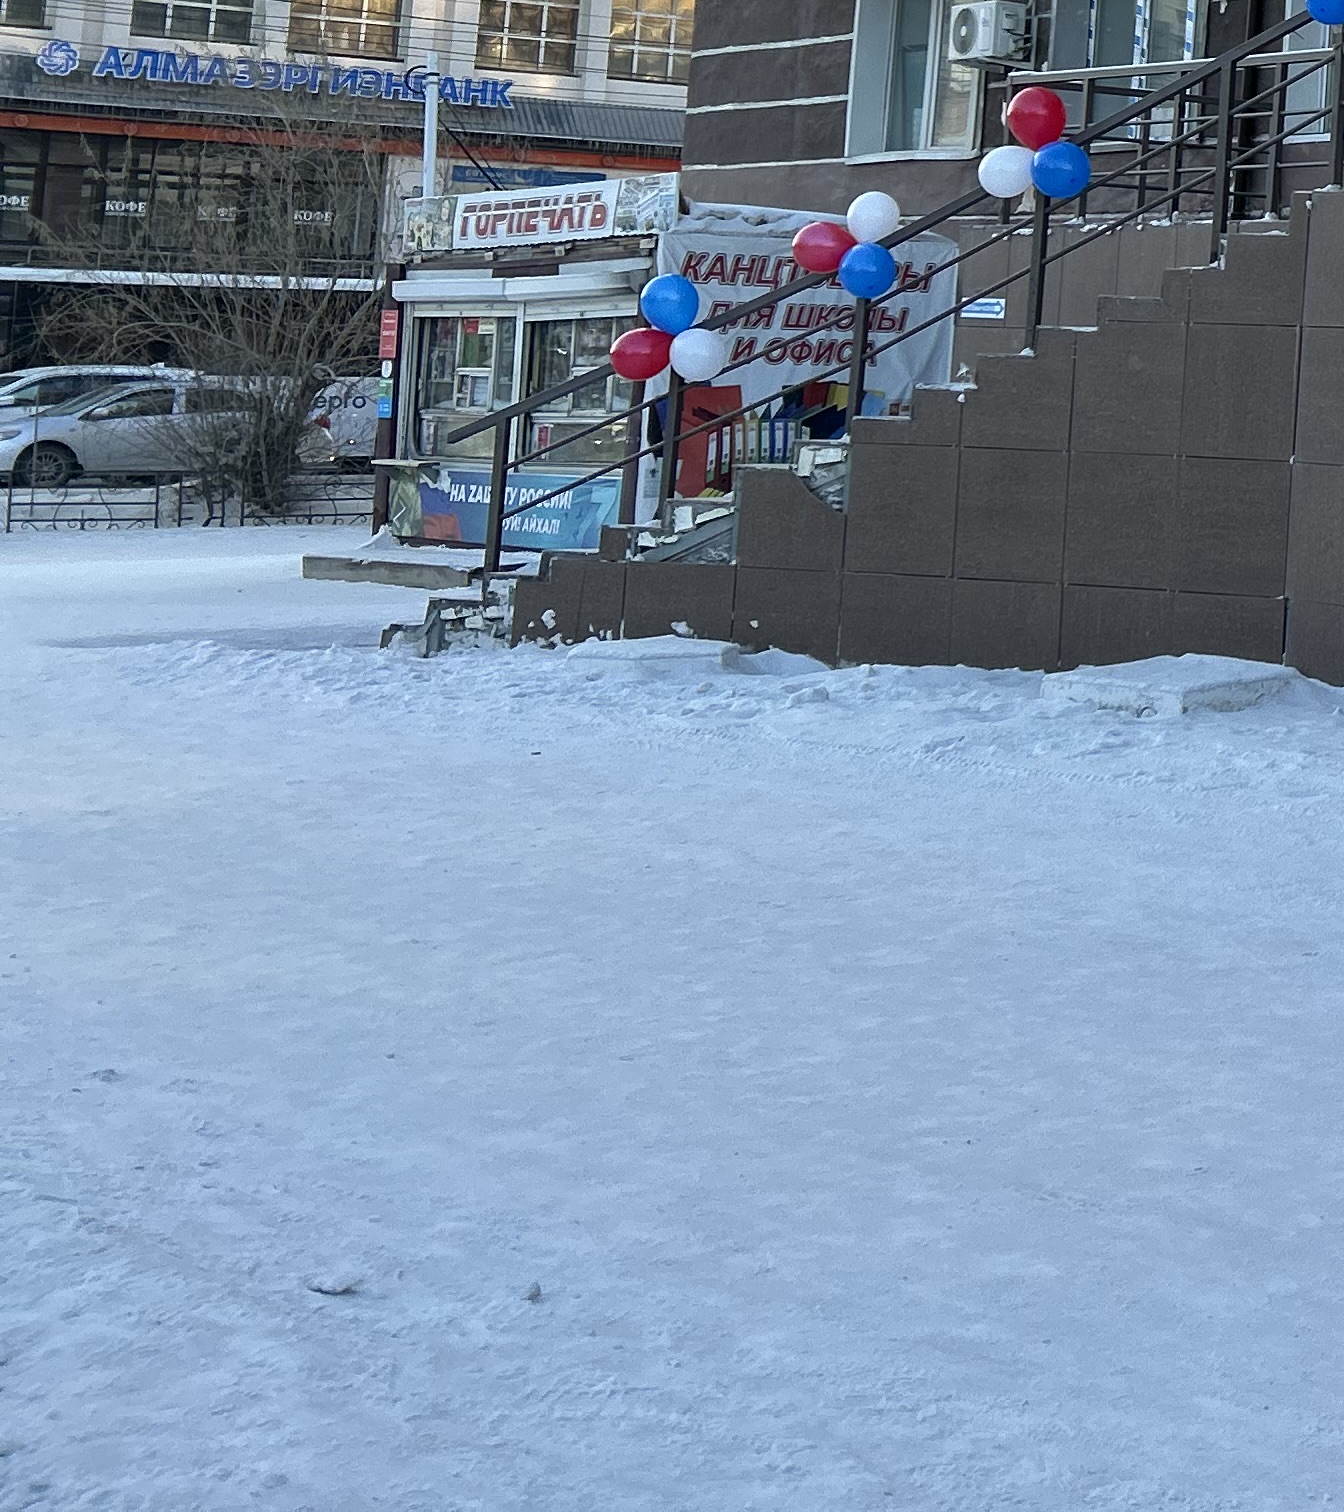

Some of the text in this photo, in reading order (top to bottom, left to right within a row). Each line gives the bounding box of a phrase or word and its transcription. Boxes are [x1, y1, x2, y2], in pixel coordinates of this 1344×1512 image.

[105, 200, 147, 213] КОФЕ
[459, 190, 608, 240] ГОРПЕЧАТЬ
[729, 336, 758, 364] И
[449, 484, 466, 502] НА
